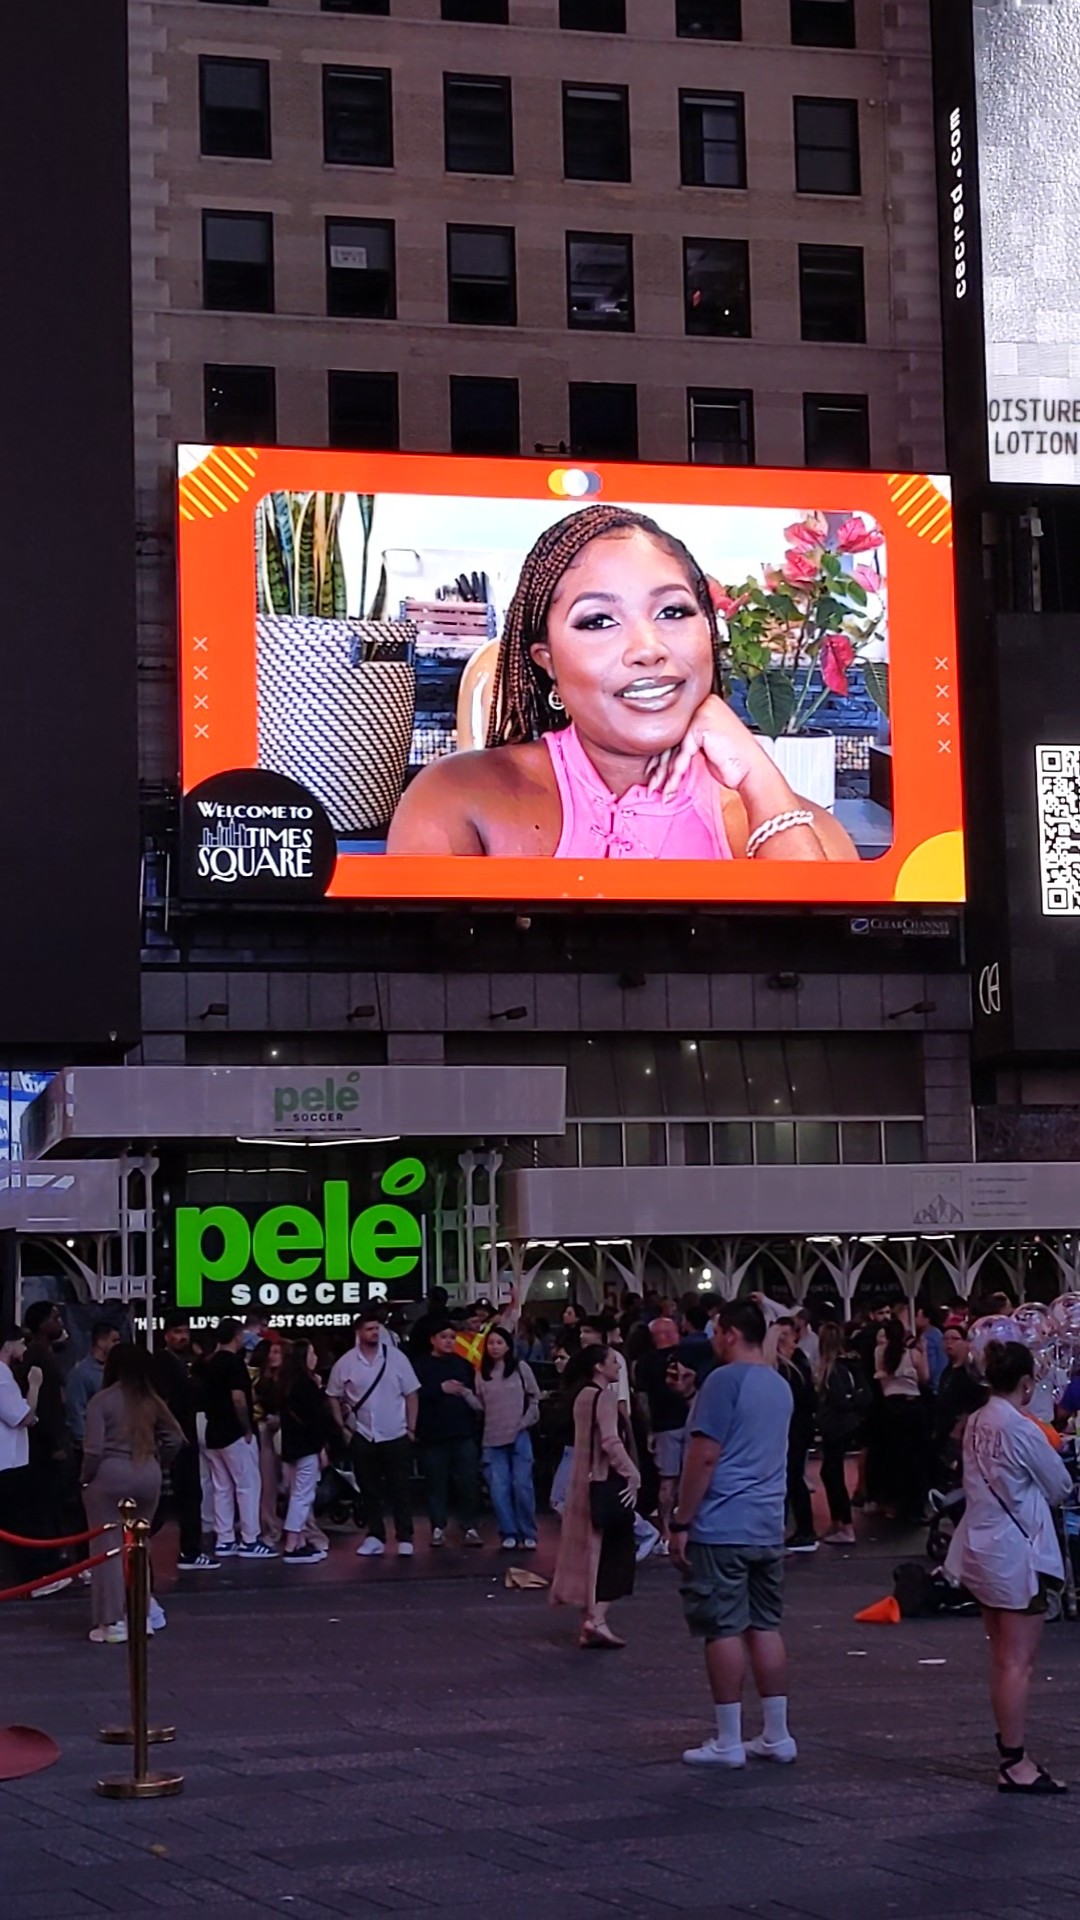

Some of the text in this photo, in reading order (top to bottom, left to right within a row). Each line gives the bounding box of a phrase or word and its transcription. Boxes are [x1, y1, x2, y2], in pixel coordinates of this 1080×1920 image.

[949, 107, 967, 299] cecred.com
[995, 431, 1078, 455] LOTION
[197, 801, 313, 819] WELCOME TO
[247, 828, 313, 848] TIMES
[197, 847, 313, 882] SQUARE
[274, 1070, 361, 1122] pelé
[292, 1112, 344, 1122] SOCCER
[175, 1157, 426, 1307] pelé
[230, 1281, 388, 1307] SOCCER
[295, 1312, 352, 1328] SOCCER
